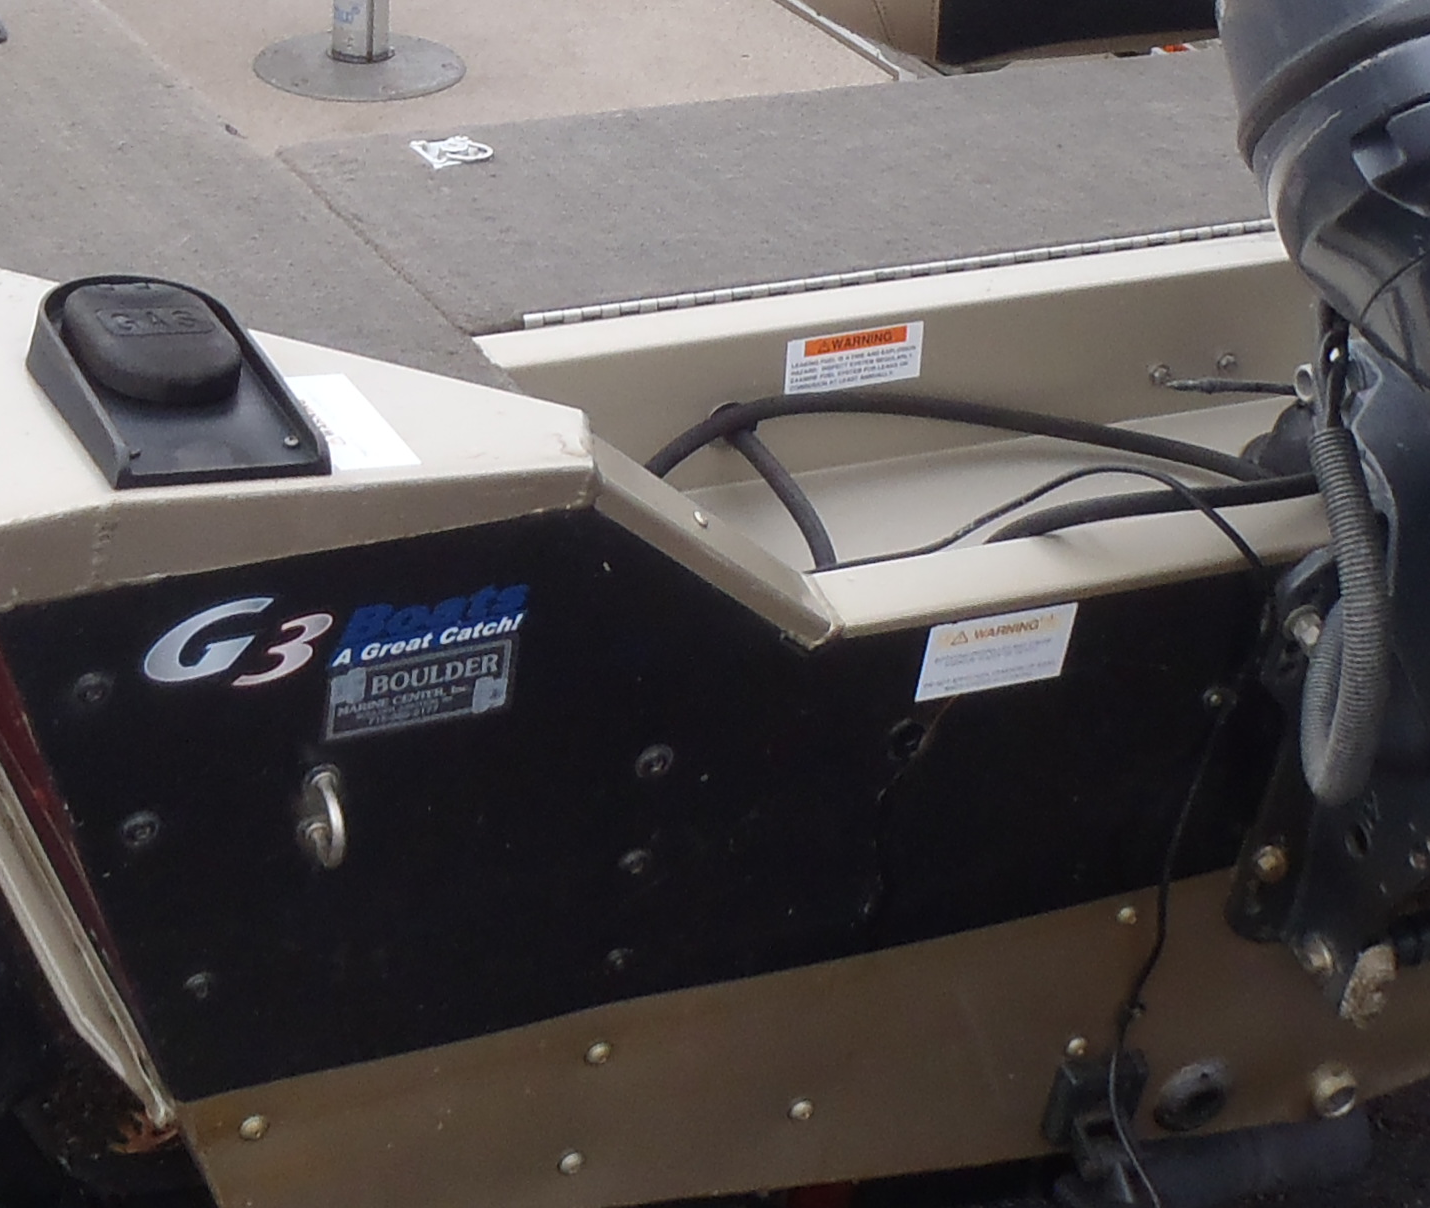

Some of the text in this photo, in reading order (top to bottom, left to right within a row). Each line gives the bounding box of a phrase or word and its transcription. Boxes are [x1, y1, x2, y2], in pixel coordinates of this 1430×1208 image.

[111, 310, 197, 330] GAS
[832, 333, 893, 350] WARNING
[347, 584, 529, 638] Boats
[144, 597, 333, 687] G3
[332, 613, 524, 668] A Great Catch!
[974, 619, 1040, 640] WARNING
[372, 653, 499, 696] BOULDER
[337, 697, 390, 717] MARINE
